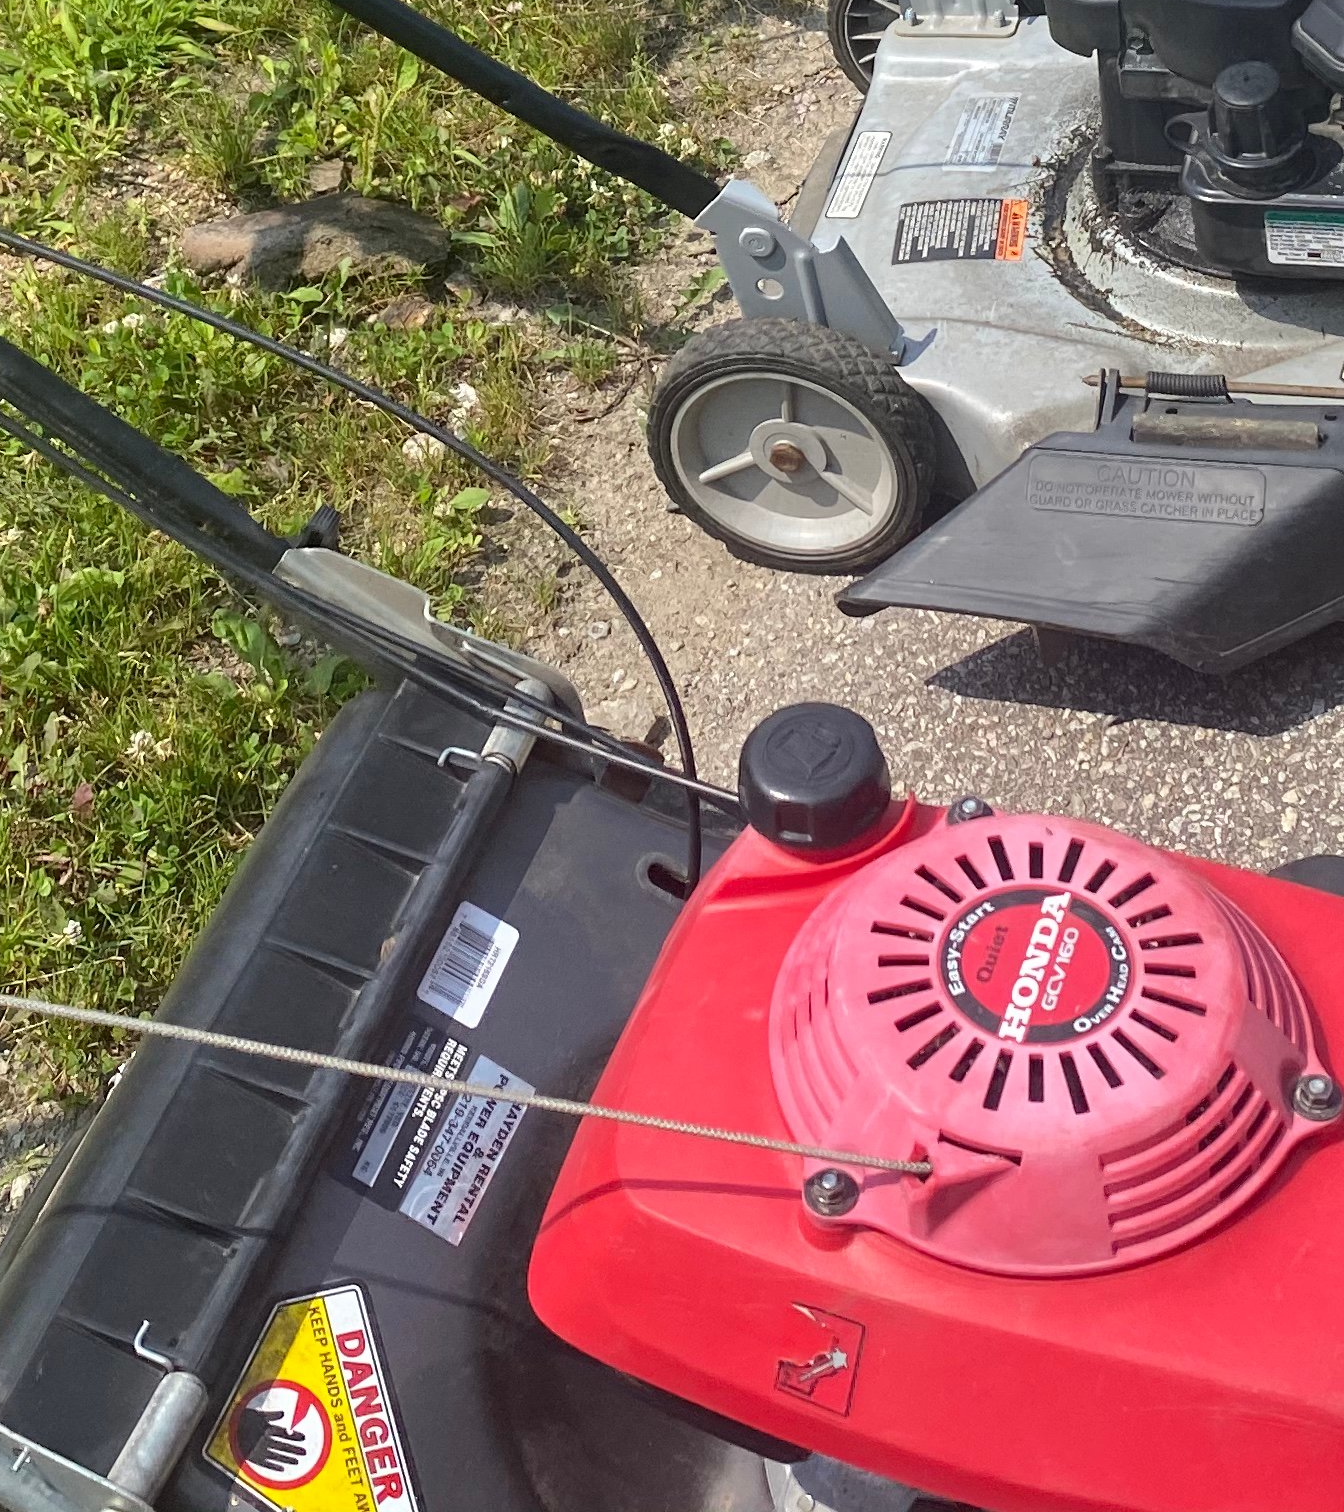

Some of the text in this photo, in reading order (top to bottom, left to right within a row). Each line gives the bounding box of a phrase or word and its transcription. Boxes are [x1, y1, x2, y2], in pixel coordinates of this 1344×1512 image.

[1029, 493, 1258, 522] GUARD OR GRASS CATCHER IN PLACE
[1035, 479, 1255, 506] DO NOT OPERATE MOWER WITHOUT
[1097, 464, 1196, 488] CAUTION
[946, 901, 996, 997] Easy-Start
[976, 924, 1009, 984] Quiet
[998, 891, 1072, 1044] HONDA
[1041, 927, 1080, 1011] GCV160
[393, 1044, 468, 1189] MEETS PSC BLADE SAFETY
[452, 1102, 522, 1224] HAYDEN RENTAL
[472, 1147, 485, 1160] &
[426, 1130, 480, 1226] EQUIPMENT
[308, 1306, 328, 1348] KEEP
[319, 1351, 343, 1409] HANDS
[332, 1412, 353, 1443] and
[343, 1445, 364, 1487] FEET
[336, 1329, 404, 1505] DANGER
